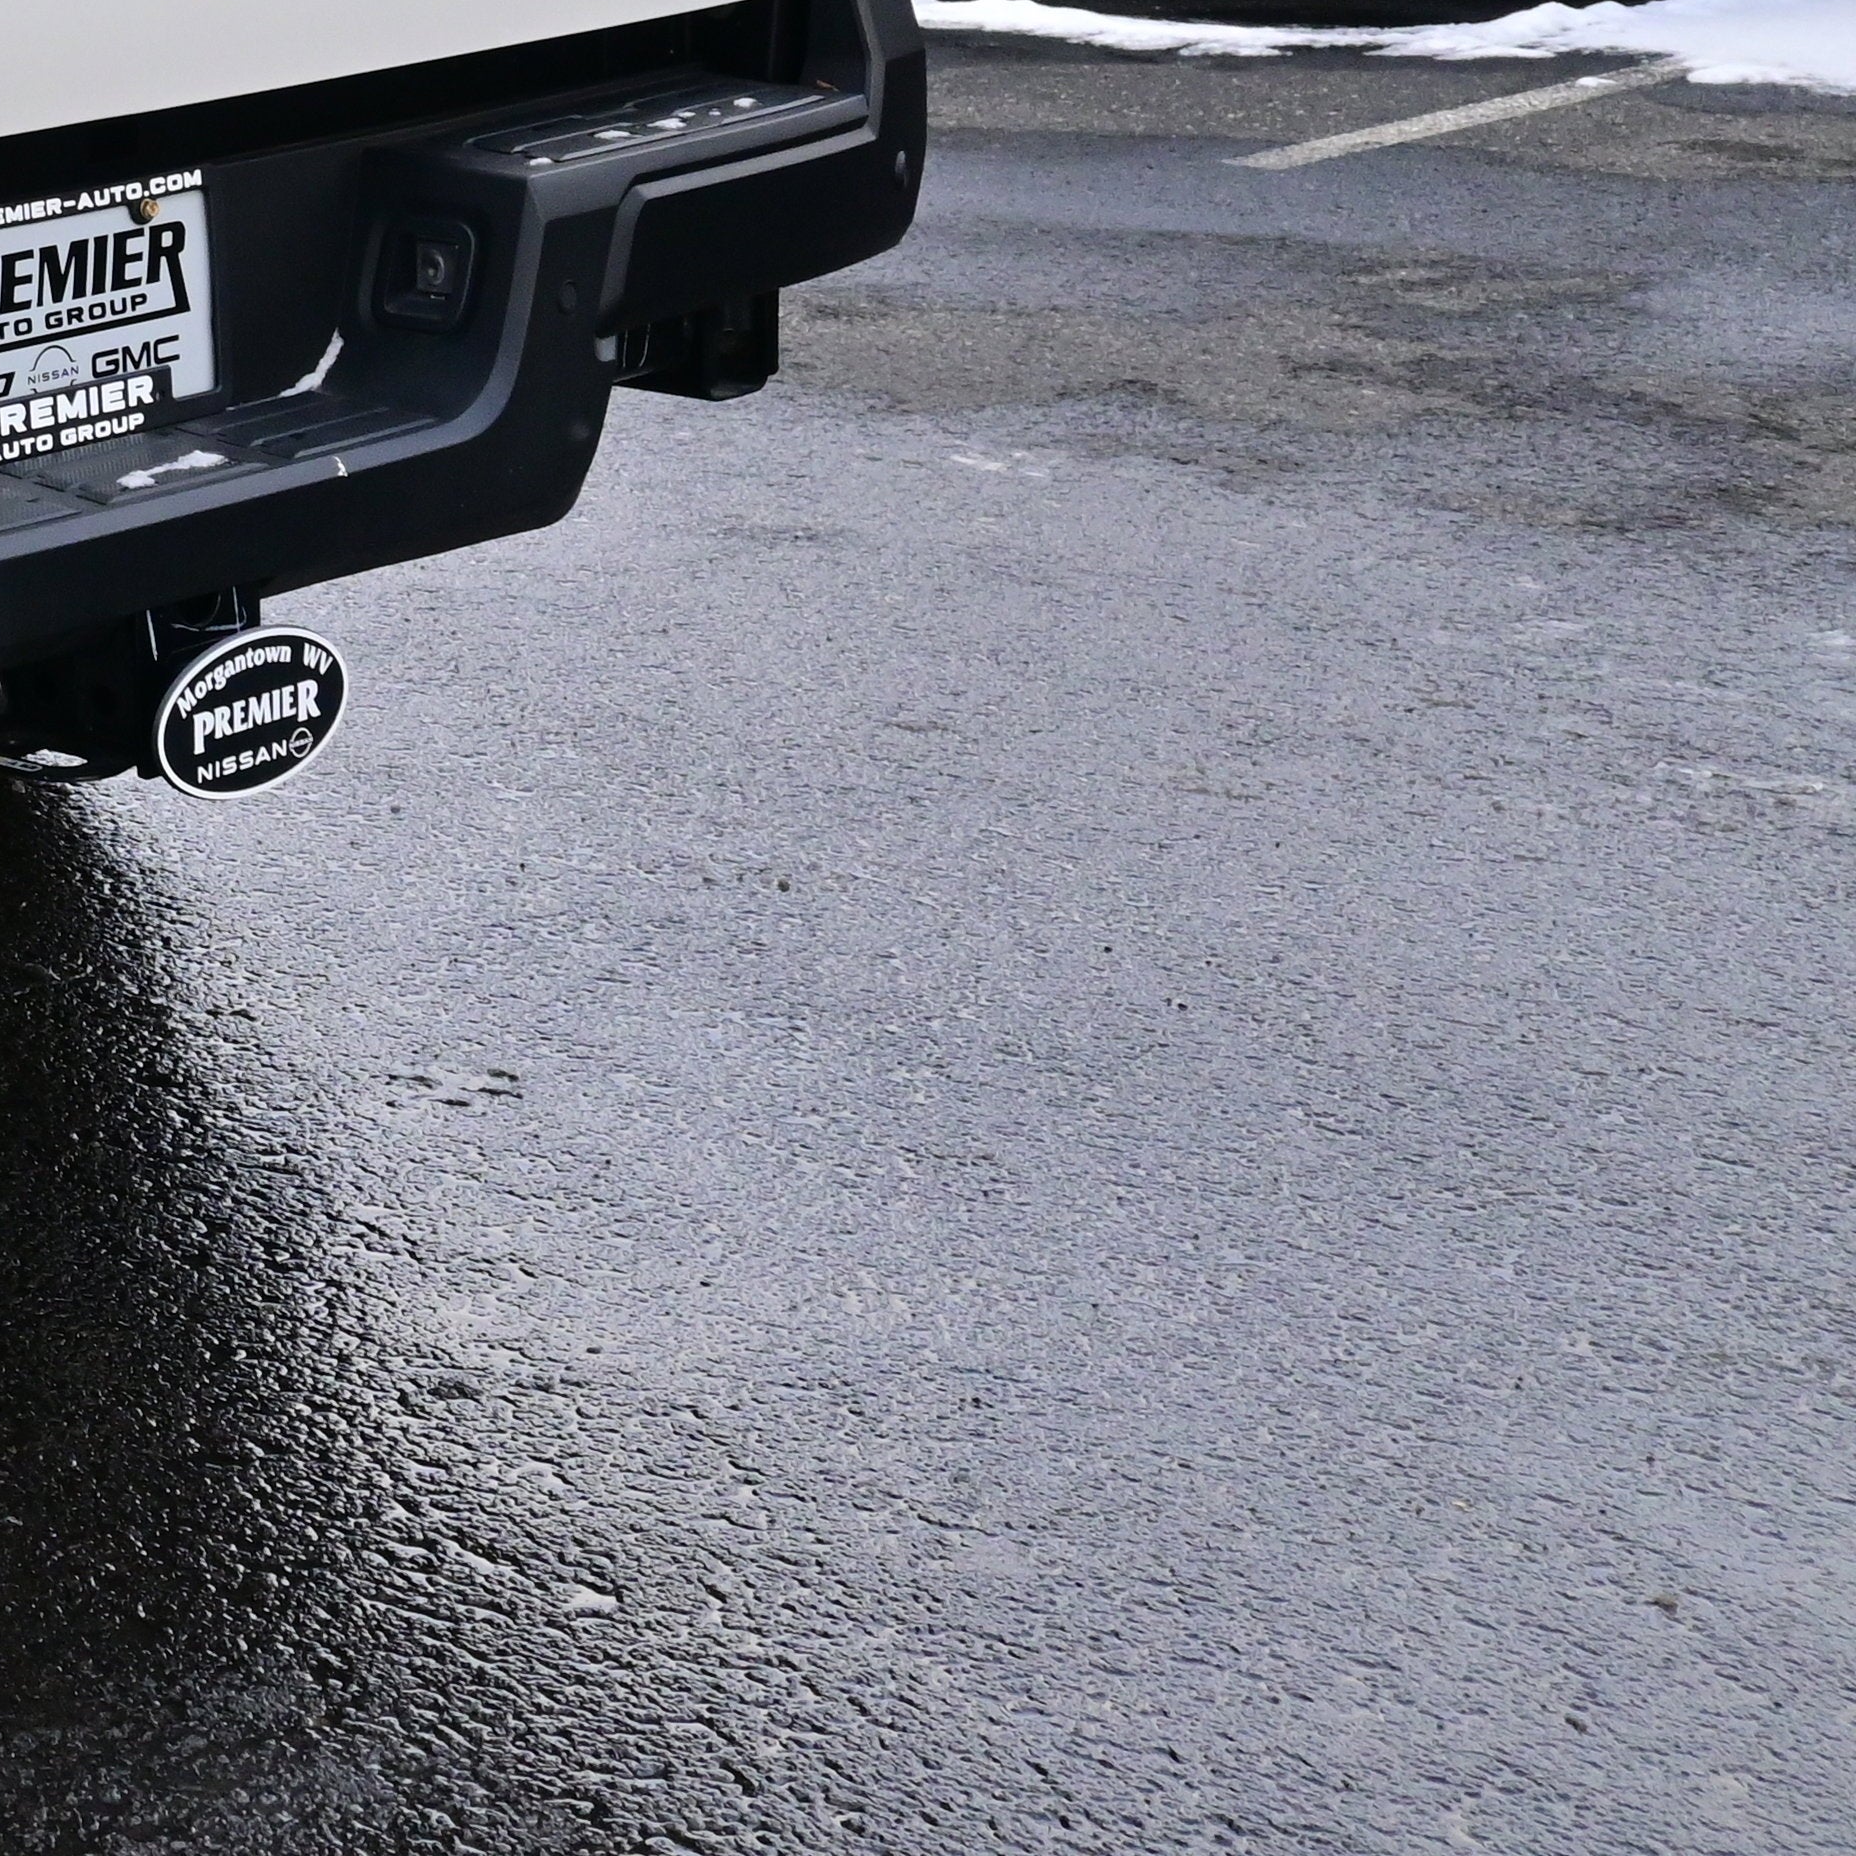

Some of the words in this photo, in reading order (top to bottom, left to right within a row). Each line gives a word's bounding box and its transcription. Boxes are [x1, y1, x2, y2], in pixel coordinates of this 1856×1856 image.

[45, 293, 148, 330] GROUP
[27, 364, 80, 386] NISSAN
[91, 334, 181, 379] GMC
[60, 412, 145, 444] GROUP
[176, 645, 292, 719] Morgantown
[302, 642, 335, 676] WV
[192, 679, 322, 755] PREMIER
[197, 739, 288, 784] NISSAN
